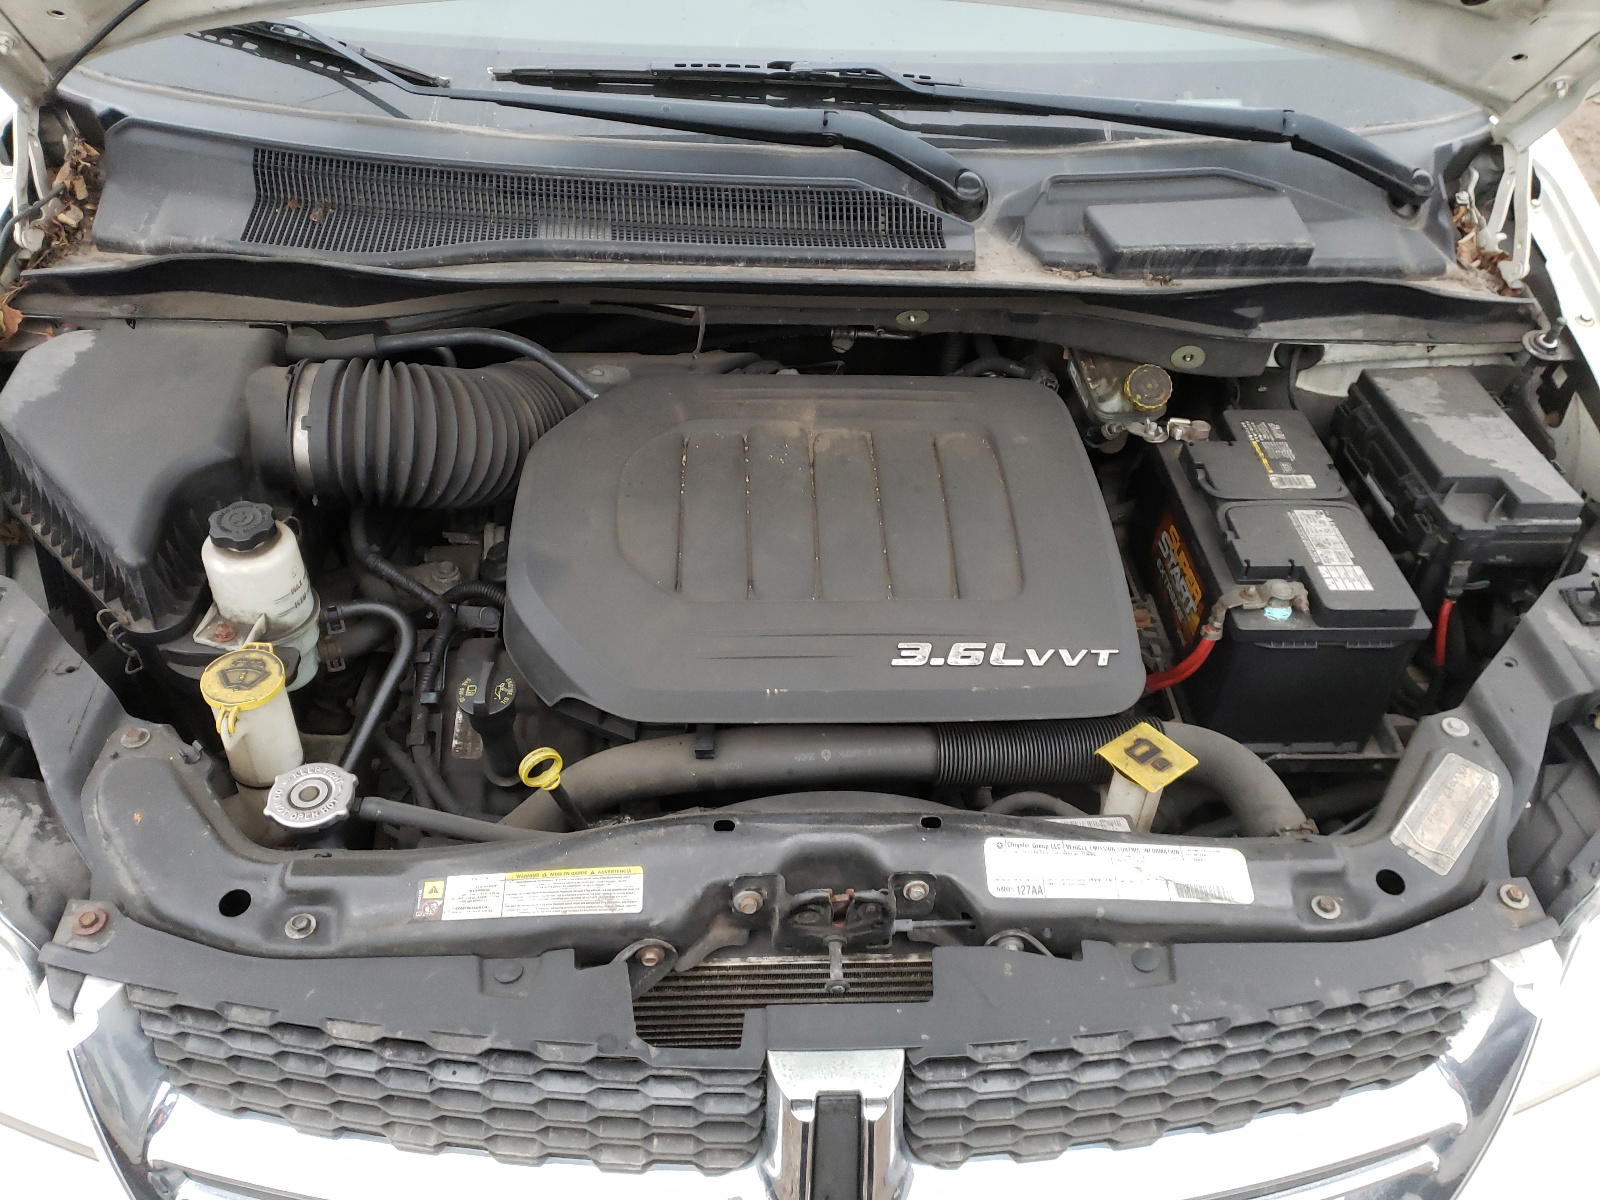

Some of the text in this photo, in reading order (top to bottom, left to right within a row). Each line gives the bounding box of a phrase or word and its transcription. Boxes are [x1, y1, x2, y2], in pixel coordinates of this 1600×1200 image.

[1158, 530, 1198, 614] START
[1168, 524, 1202, 606] SUPER
[891, 642, 1119, 667] 3.6L VVT
[1016, 884, 1044, 896] 127AA
